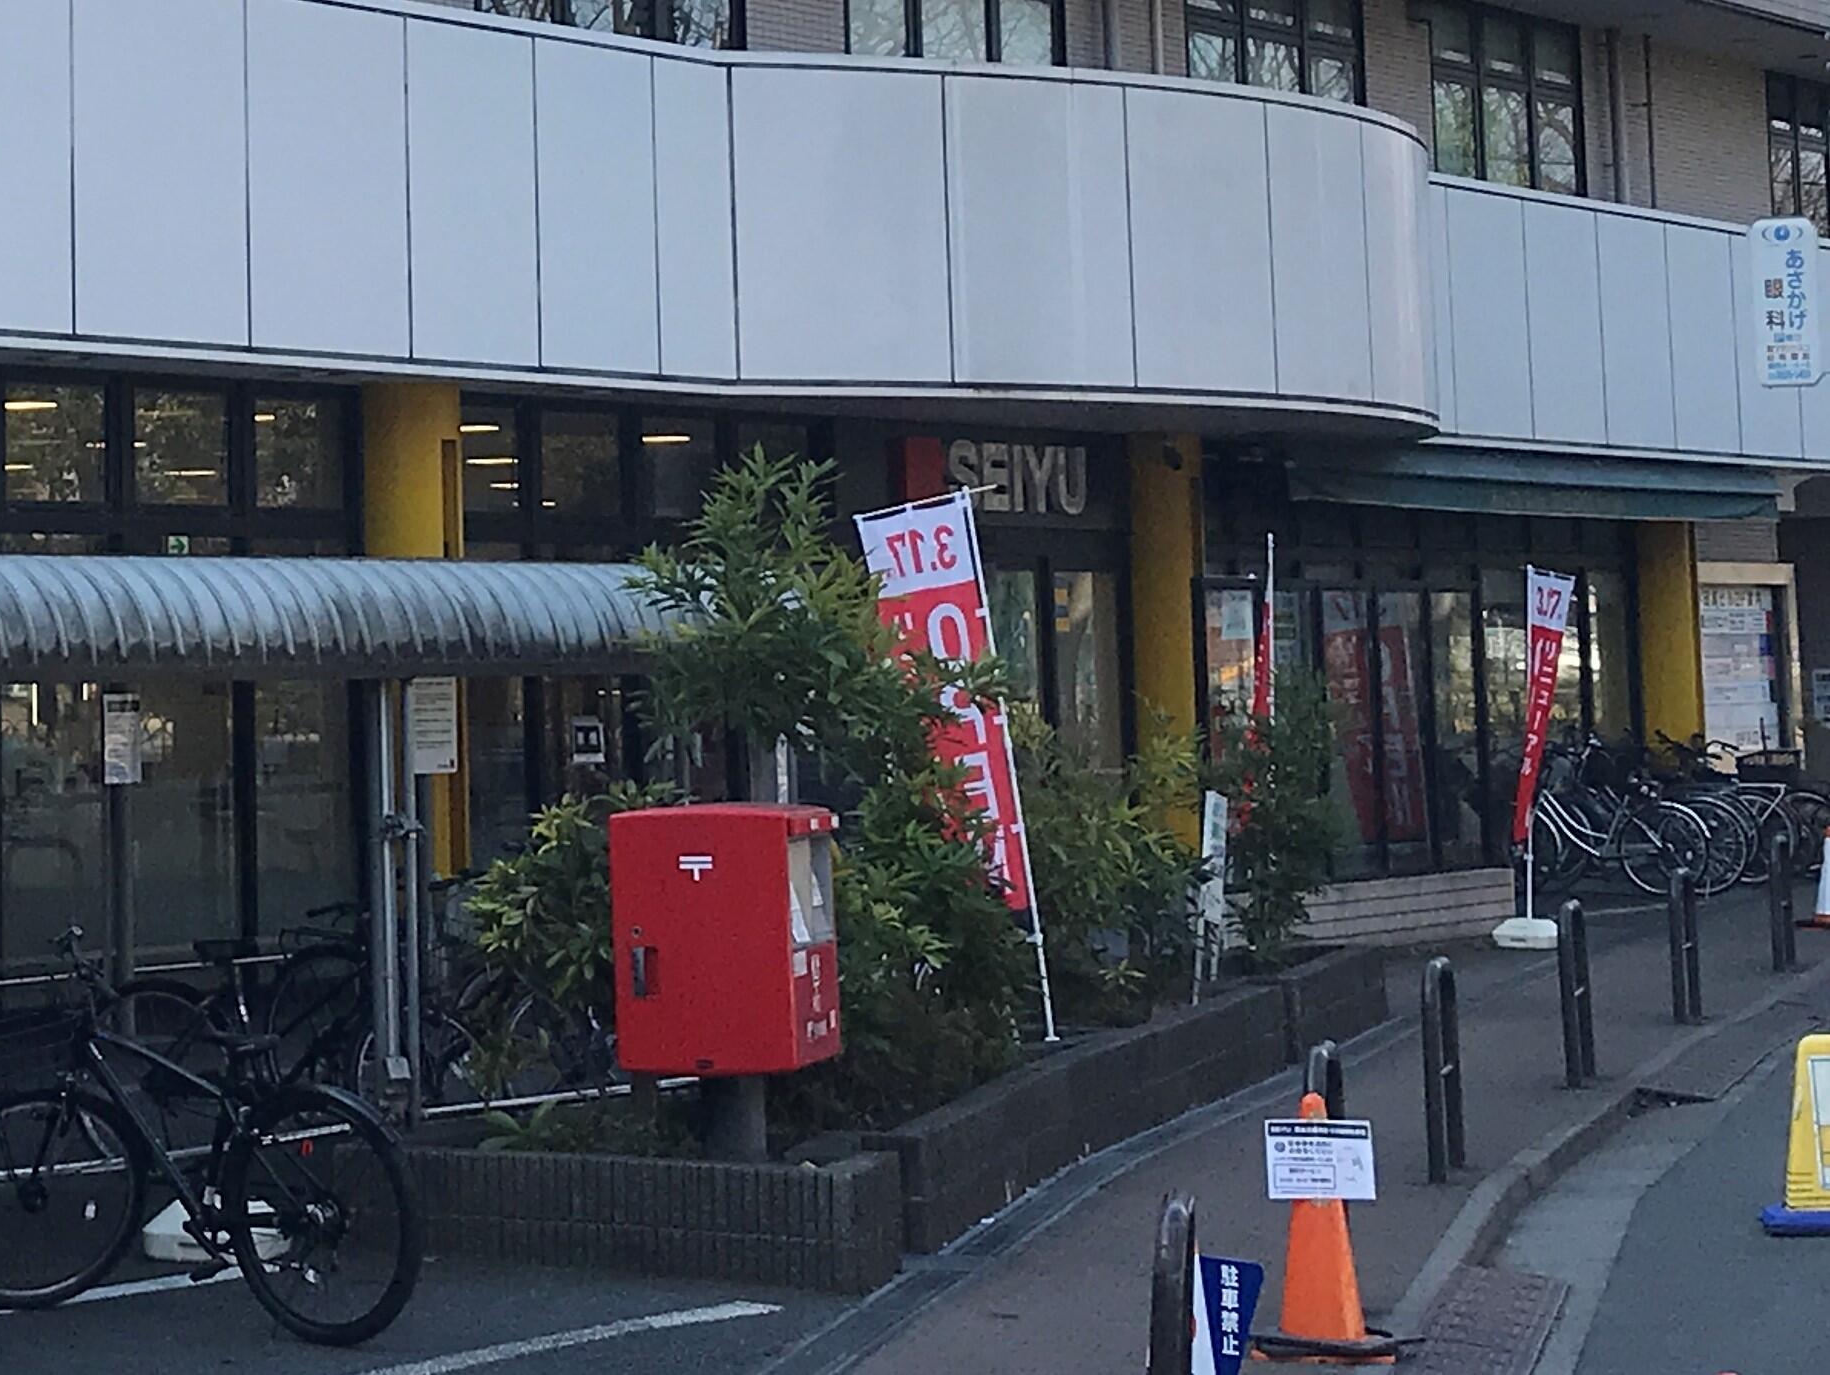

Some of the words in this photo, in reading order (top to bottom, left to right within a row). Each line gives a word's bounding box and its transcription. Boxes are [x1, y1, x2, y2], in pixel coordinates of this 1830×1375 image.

[1785, 248, 1807, 330] あさかげ
[948, 439, 1087, 515] SEIYU
[1219, 1263, 1240, 1356] 駐車禁止
